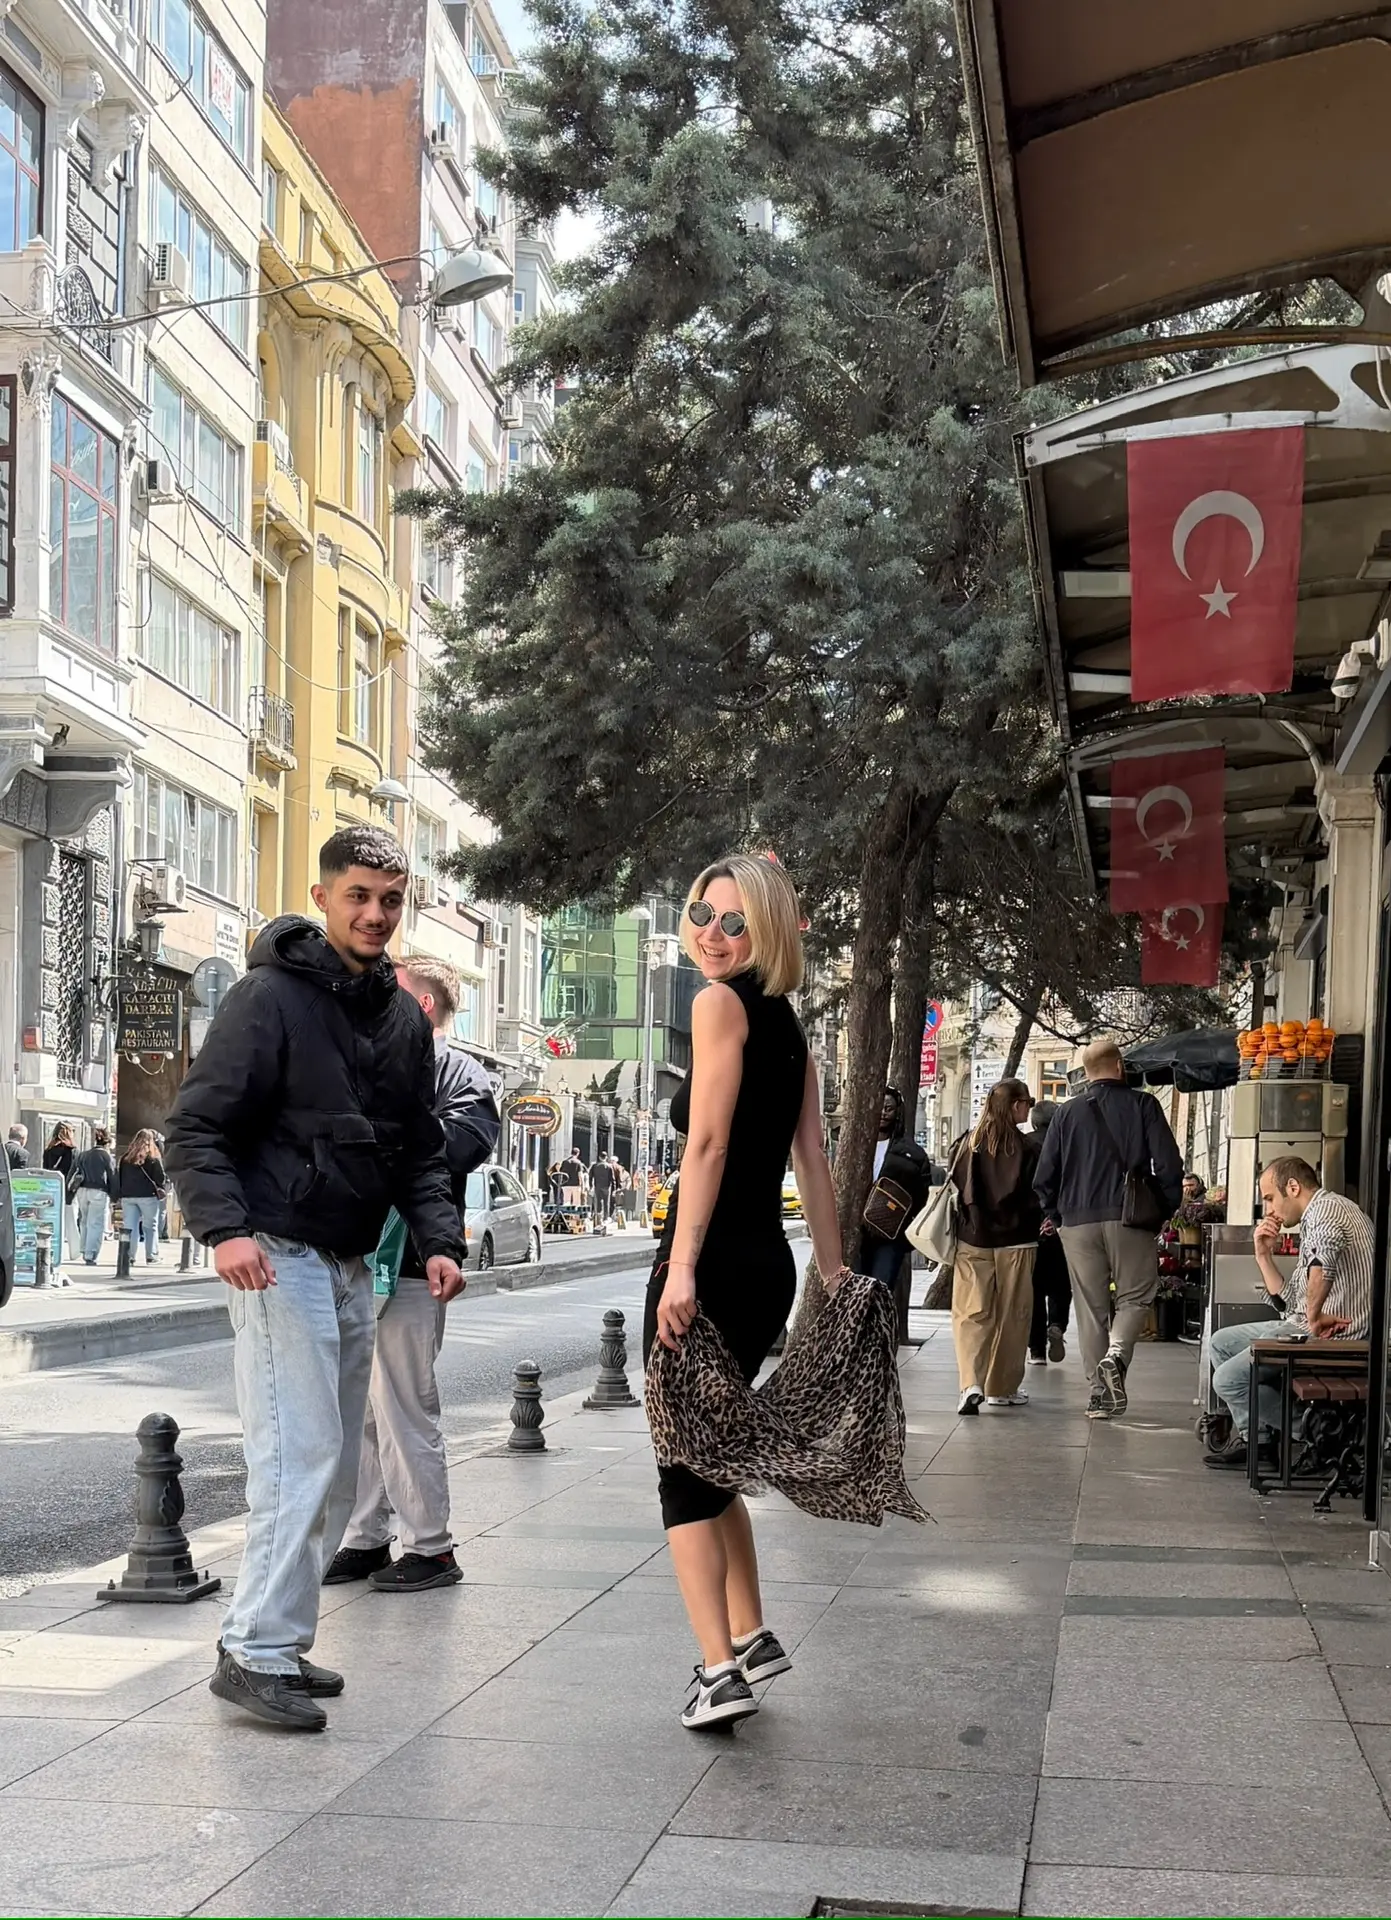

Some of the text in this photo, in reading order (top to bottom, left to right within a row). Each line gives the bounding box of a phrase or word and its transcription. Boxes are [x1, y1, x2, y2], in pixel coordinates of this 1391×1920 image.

[122, 993, 177, 1003] KARACHI
[124, 1004, 174, 1014] DARBAR
[125, 1029, 173, 1038] PAKISTANI
[121, 1039, 176, 1048] RESTAURANT
